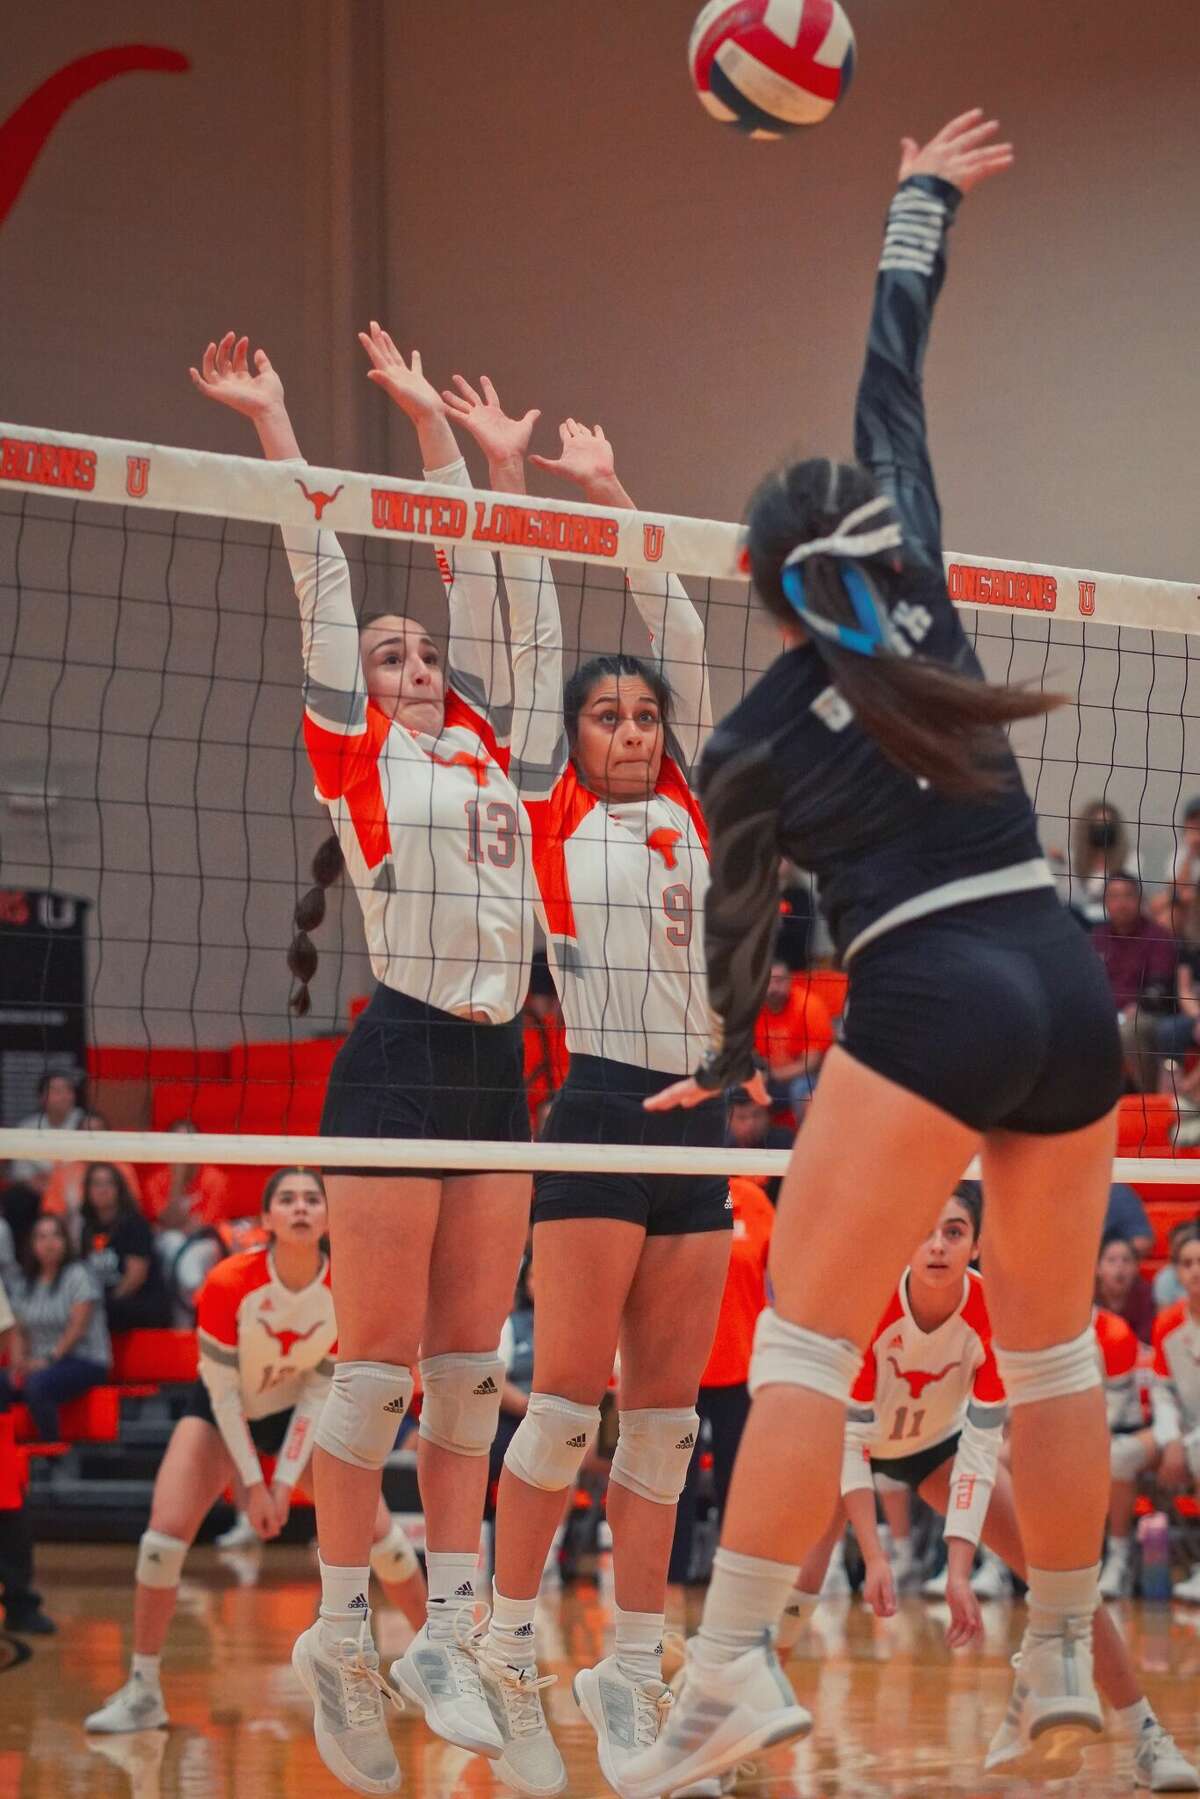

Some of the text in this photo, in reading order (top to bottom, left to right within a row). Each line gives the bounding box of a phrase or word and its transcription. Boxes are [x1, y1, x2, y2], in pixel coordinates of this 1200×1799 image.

[0, 438, 150, 498] HORNS U
[371, 488, 665, 562] UNITED LONGHORNS U
[948, 563, 1096, 616] ONGHORNS U
[464, 799, 518, 869] 13
[662, 883, 692, 947] 9
[889, 1406, 925, 1441] 11
